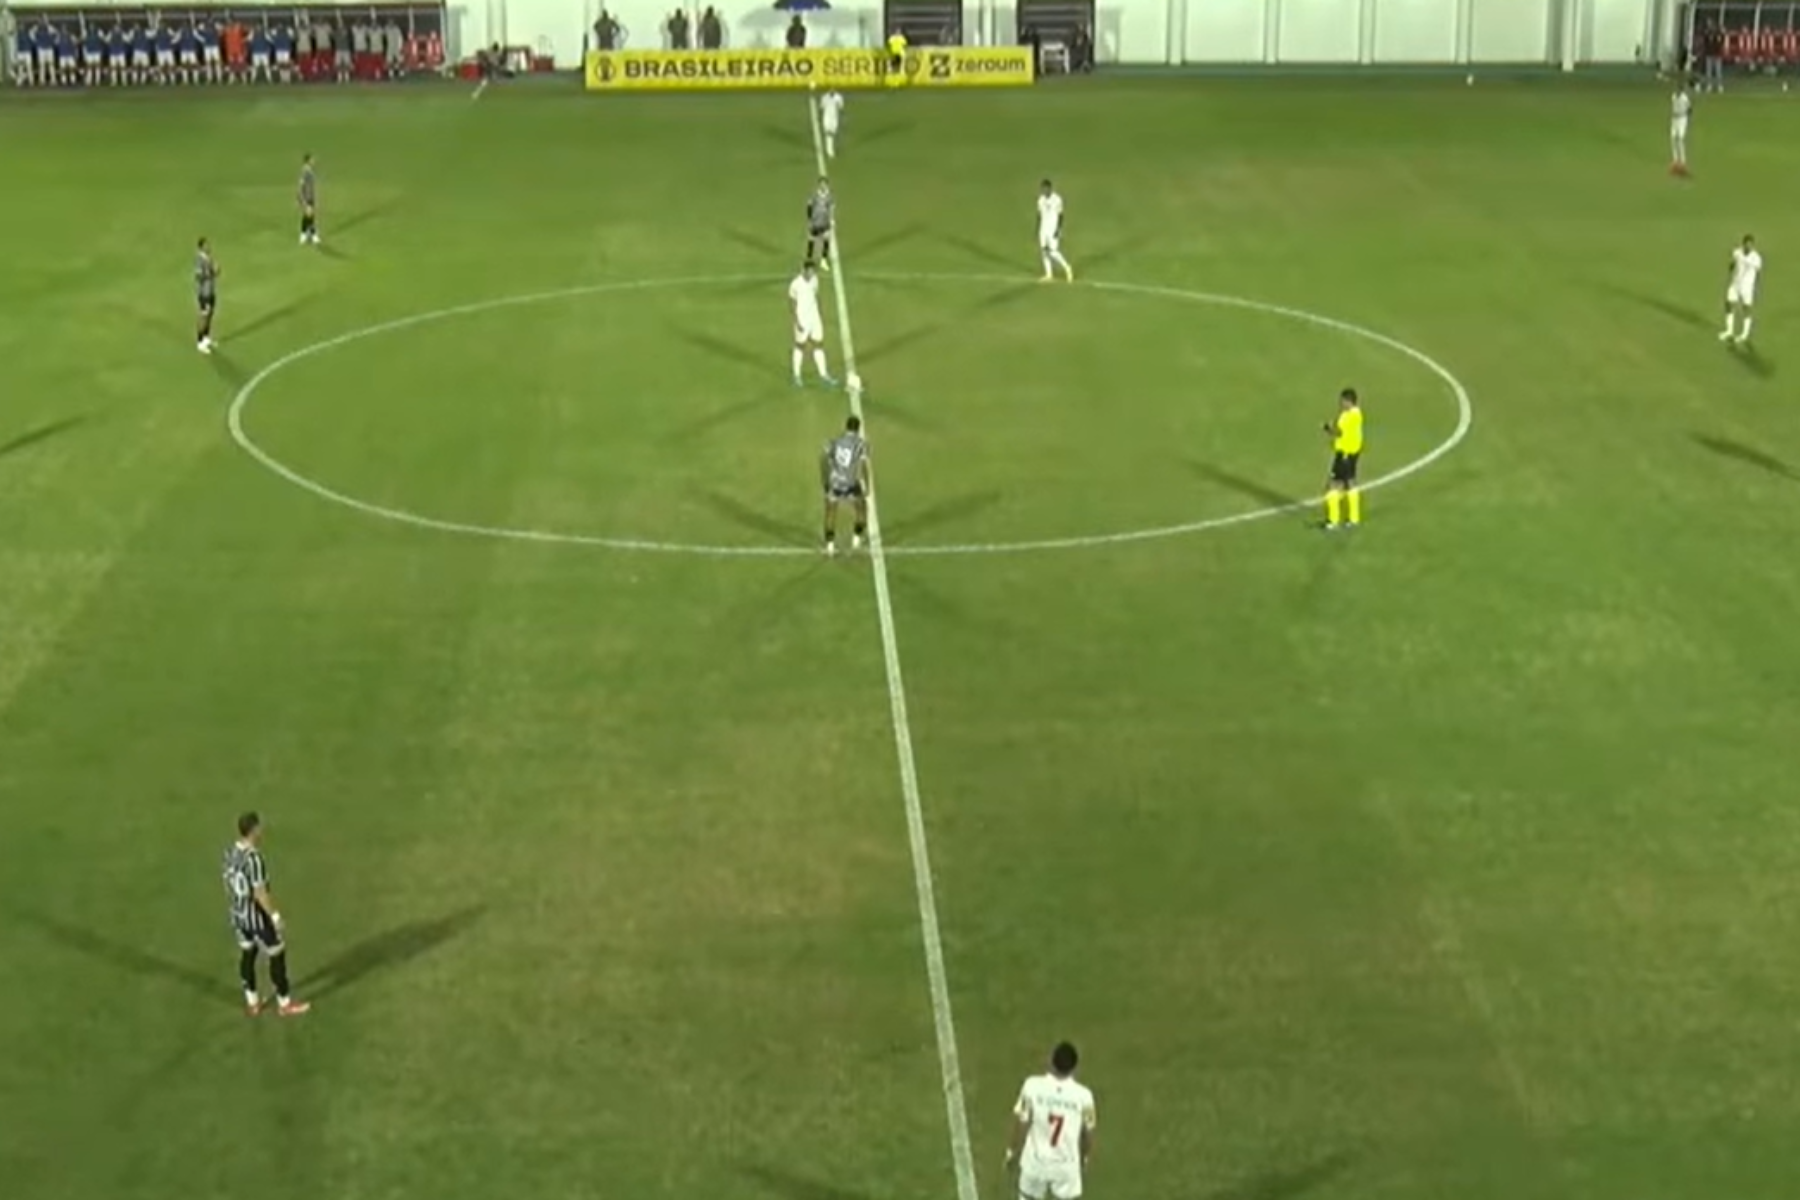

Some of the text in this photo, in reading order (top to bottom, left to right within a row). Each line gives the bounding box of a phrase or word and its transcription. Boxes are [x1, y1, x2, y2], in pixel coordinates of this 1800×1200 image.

[624, 54, 815, 78] BRASILEIRÃO
[955, 57, 1026, 72] zeroum
[1048, 1113, 1065, 1148] 7
